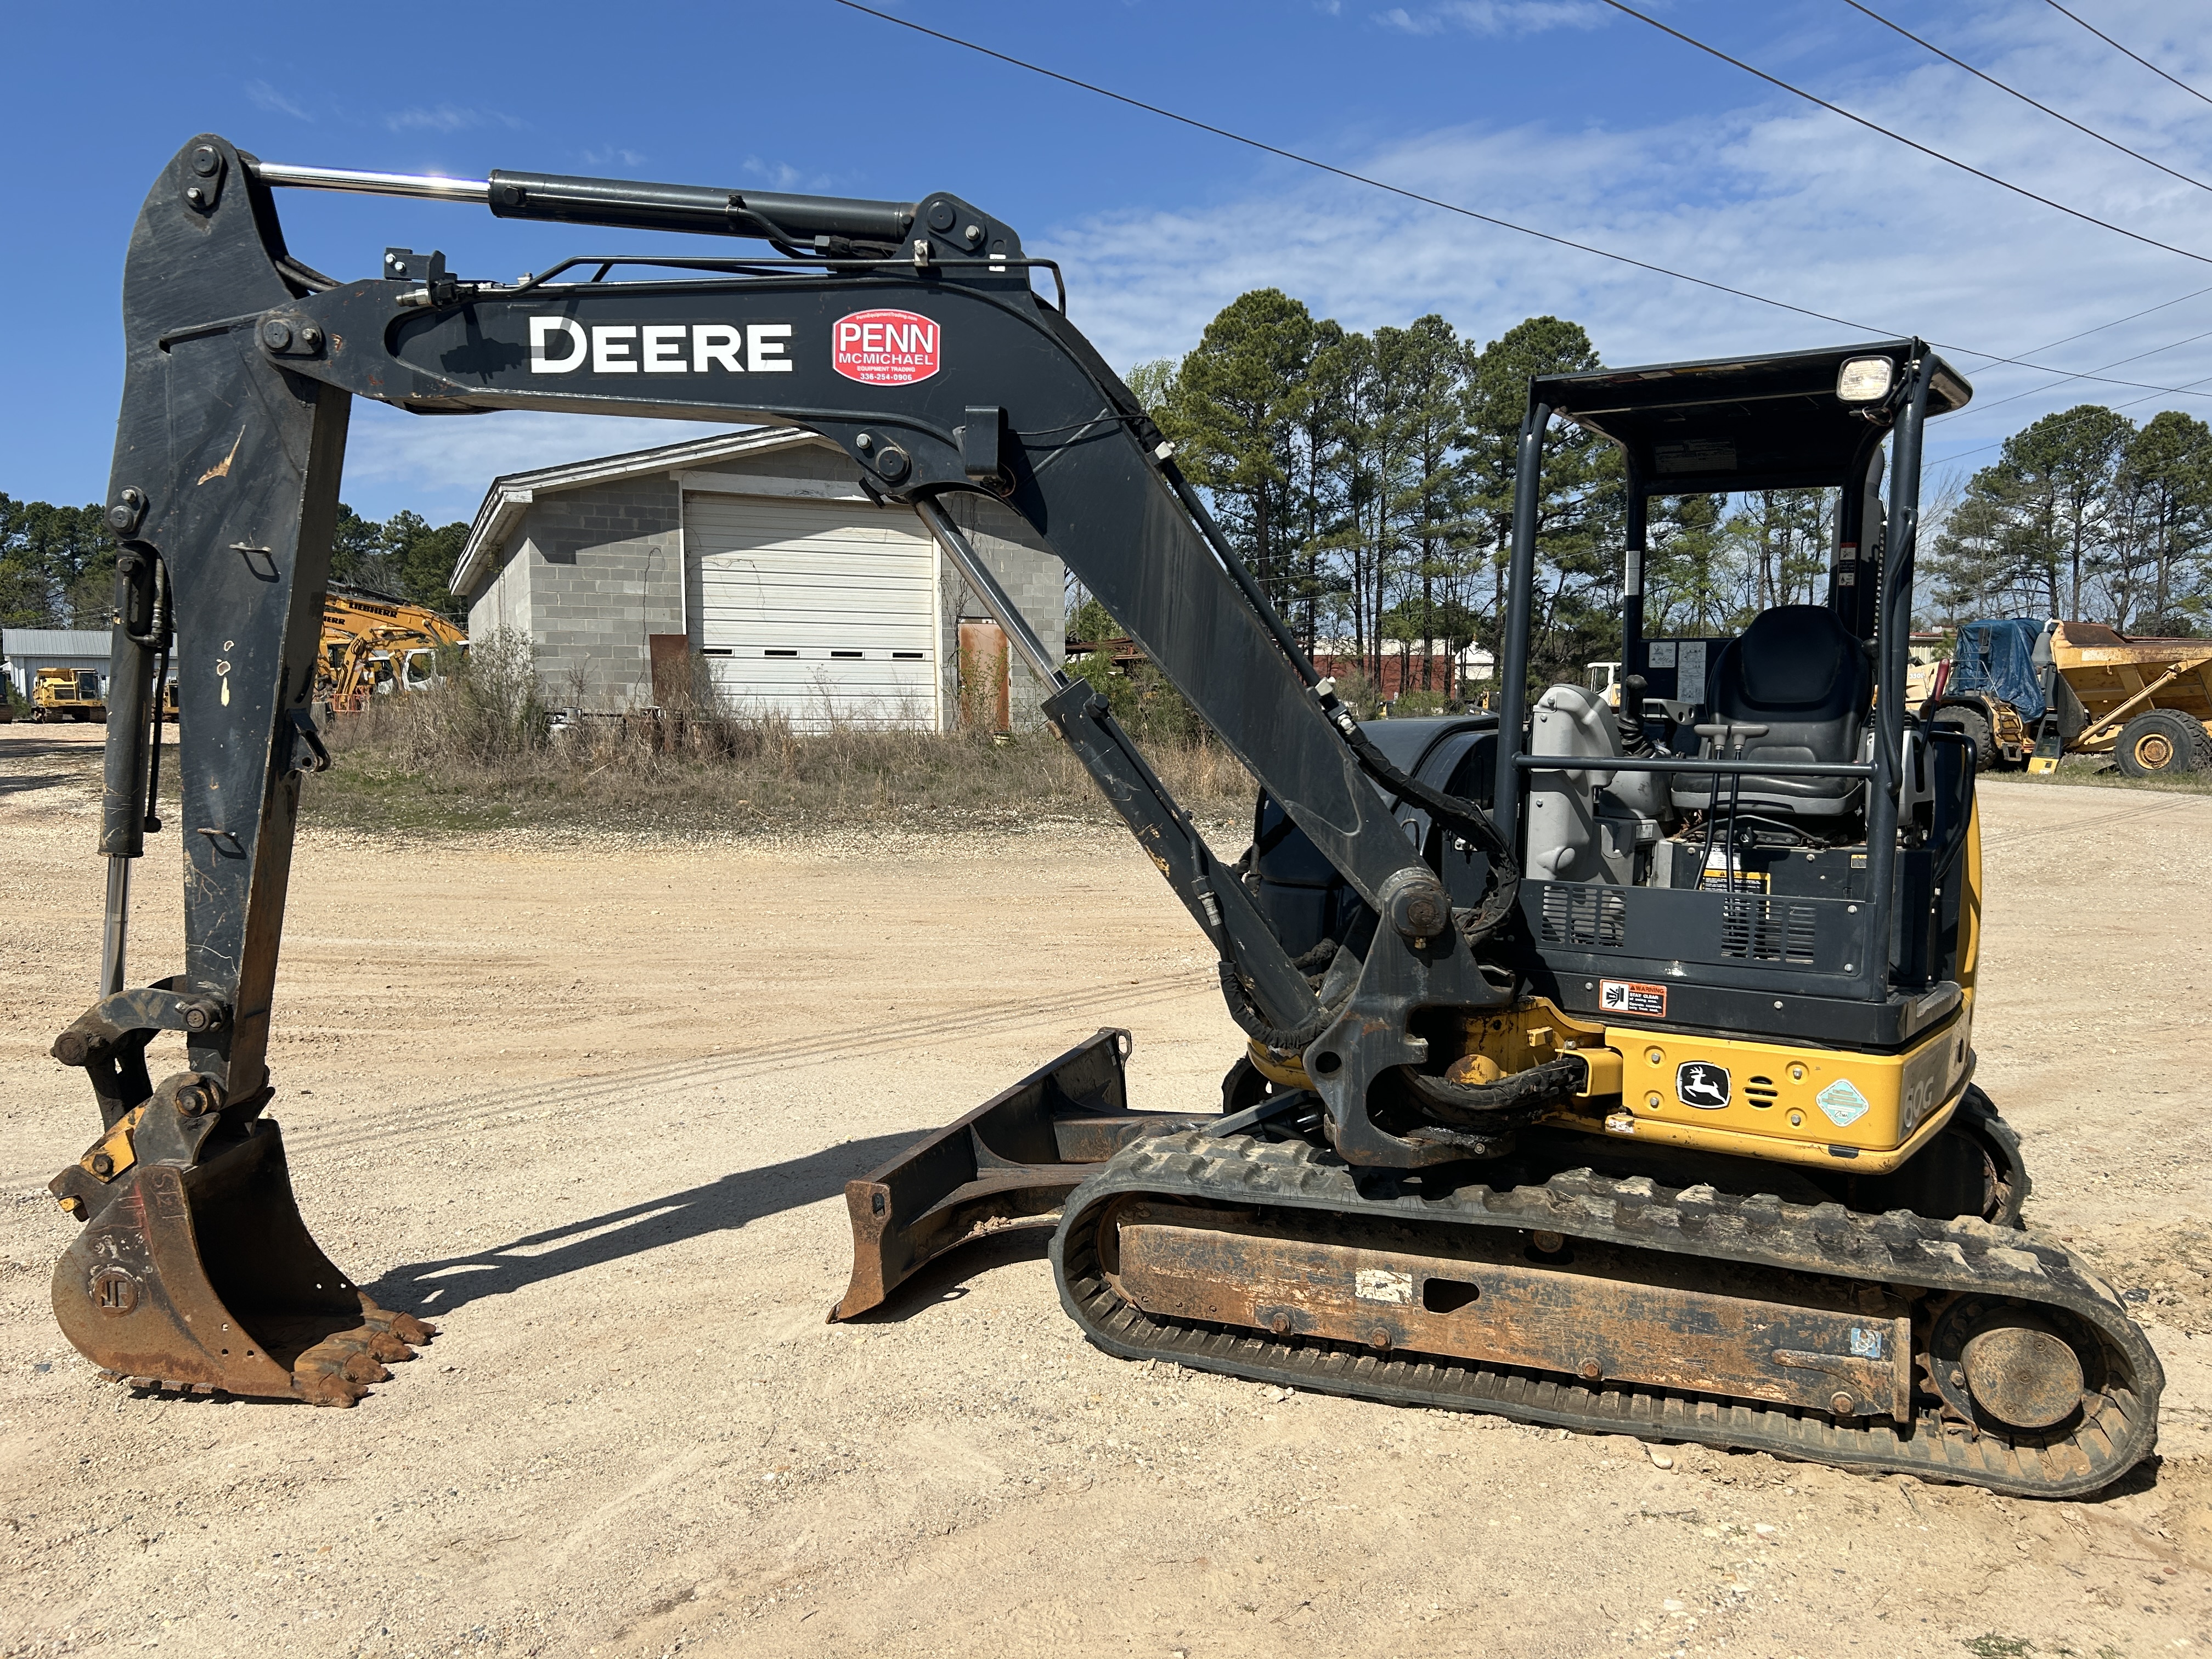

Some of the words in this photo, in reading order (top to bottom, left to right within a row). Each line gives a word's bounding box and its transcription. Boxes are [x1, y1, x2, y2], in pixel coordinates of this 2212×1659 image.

[529, 317, 792, 373] DEERE
[840, 323, 933, 353] PENN
[839, 353, 933, 365] MCMICHAEL
[349, 602, 398, 618] LIEBHERR
[1636, 985, 1664, 994] WARNING
[1904, 1076, 1934, 1128] 60G
